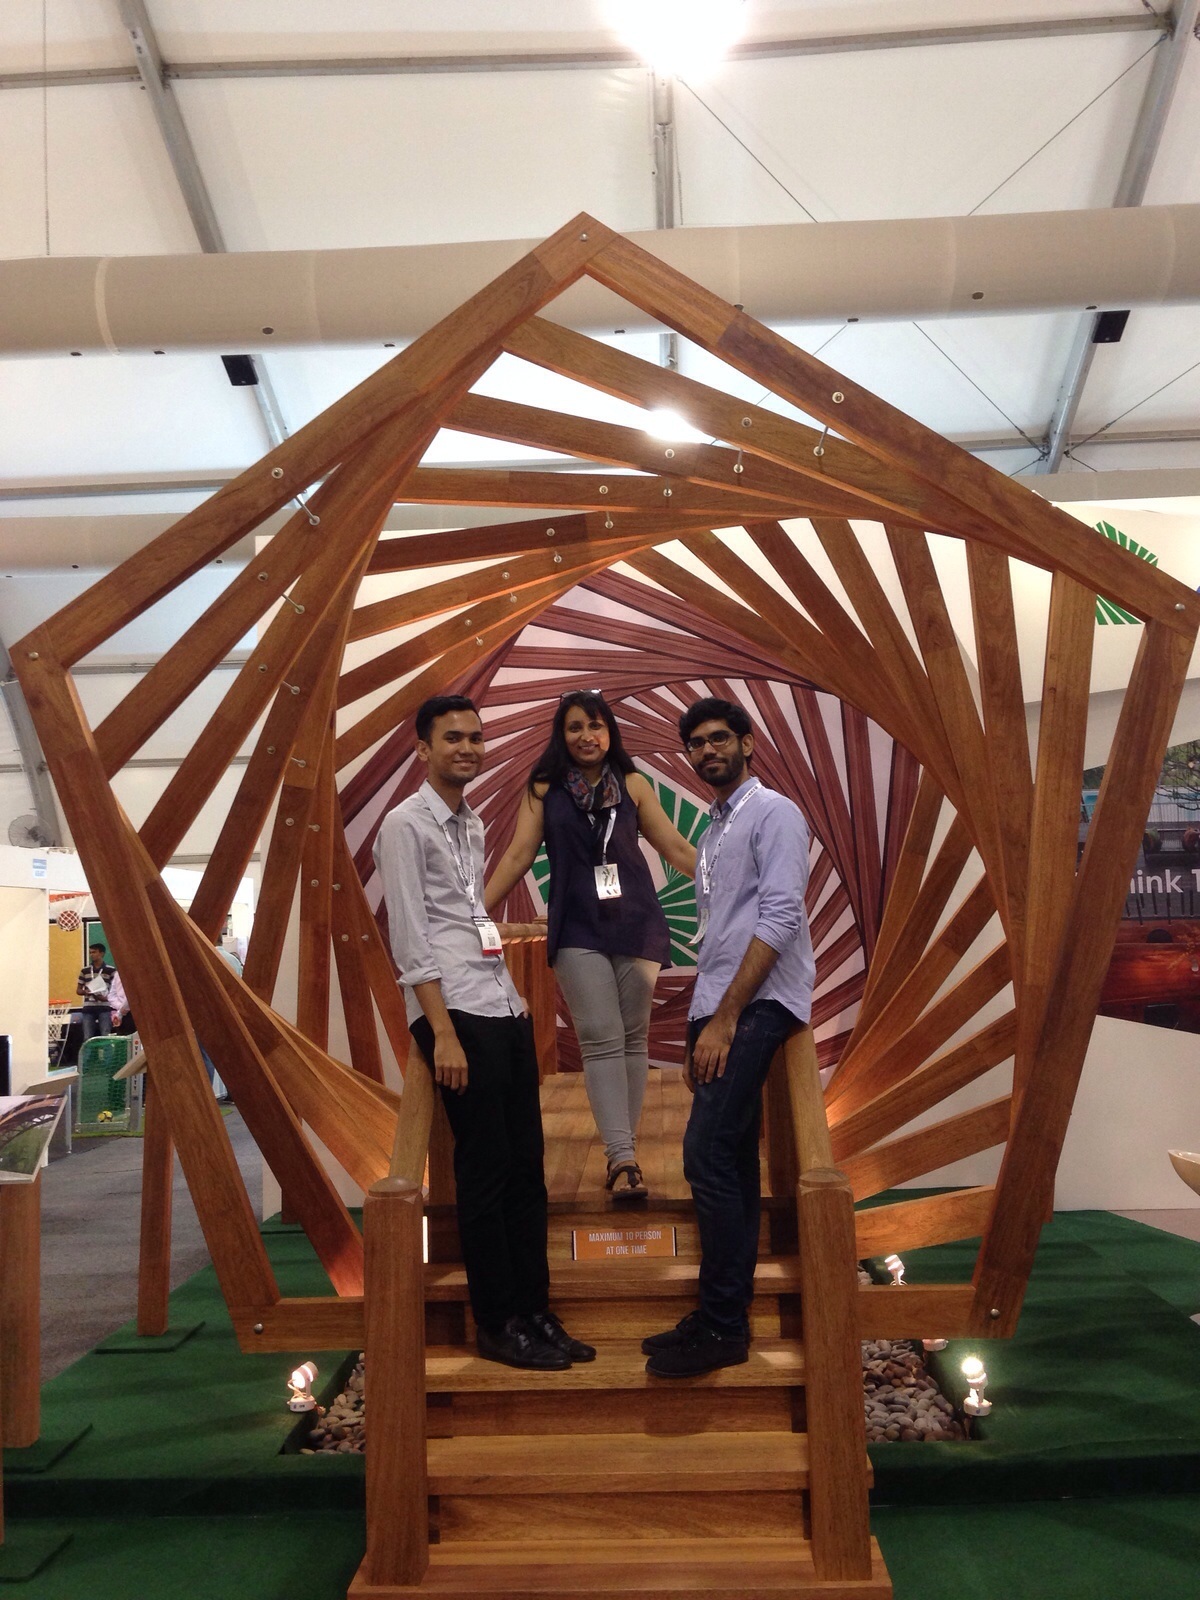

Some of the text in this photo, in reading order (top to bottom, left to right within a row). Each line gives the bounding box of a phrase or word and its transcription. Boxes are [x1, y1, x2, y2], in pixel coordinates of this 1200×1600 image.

[589, 1231, 661, 1241] MAXIMUM 10 PERSON
[606, 1244, 647, 1255] AT ONE TIME
